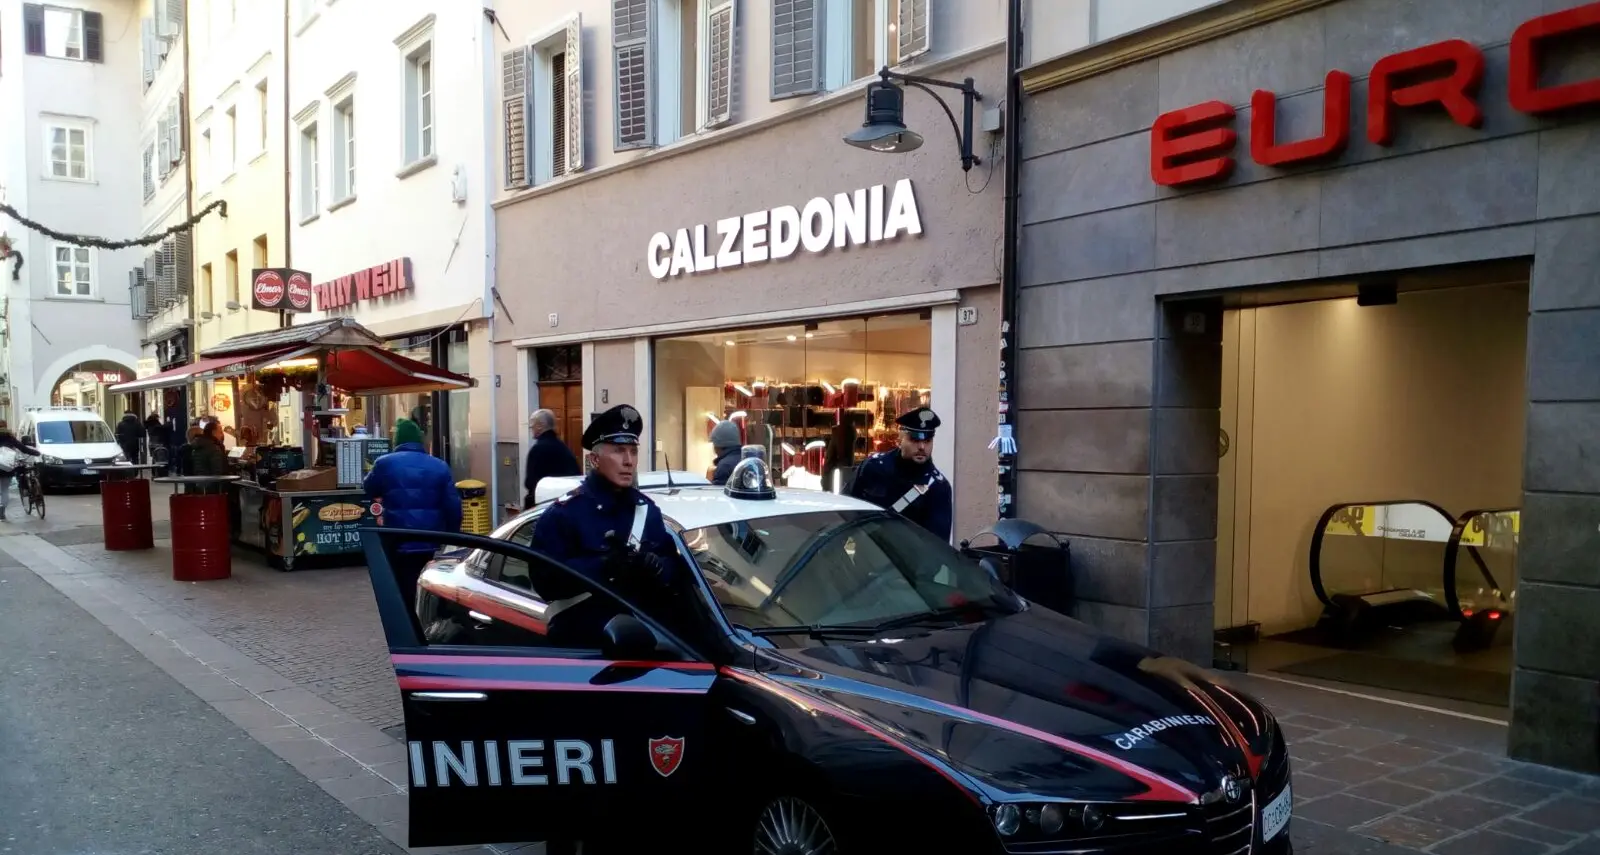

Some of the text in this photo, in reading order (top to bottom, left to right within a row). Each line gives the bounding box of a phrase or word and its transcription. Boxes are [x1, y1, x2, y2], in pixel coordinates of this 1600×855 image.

[647, 178, 922, 279] CALZEDONIA
[255, 282, 282, 294] Elmar
[314, 273, 355, 311] TALLY
[103, 373, 121, 382] KOI
[344, 531, 360, 542] DO
[1115, 714, 1216, 750] CARABINIERI
[408, 738, 617, 787] INIERI
